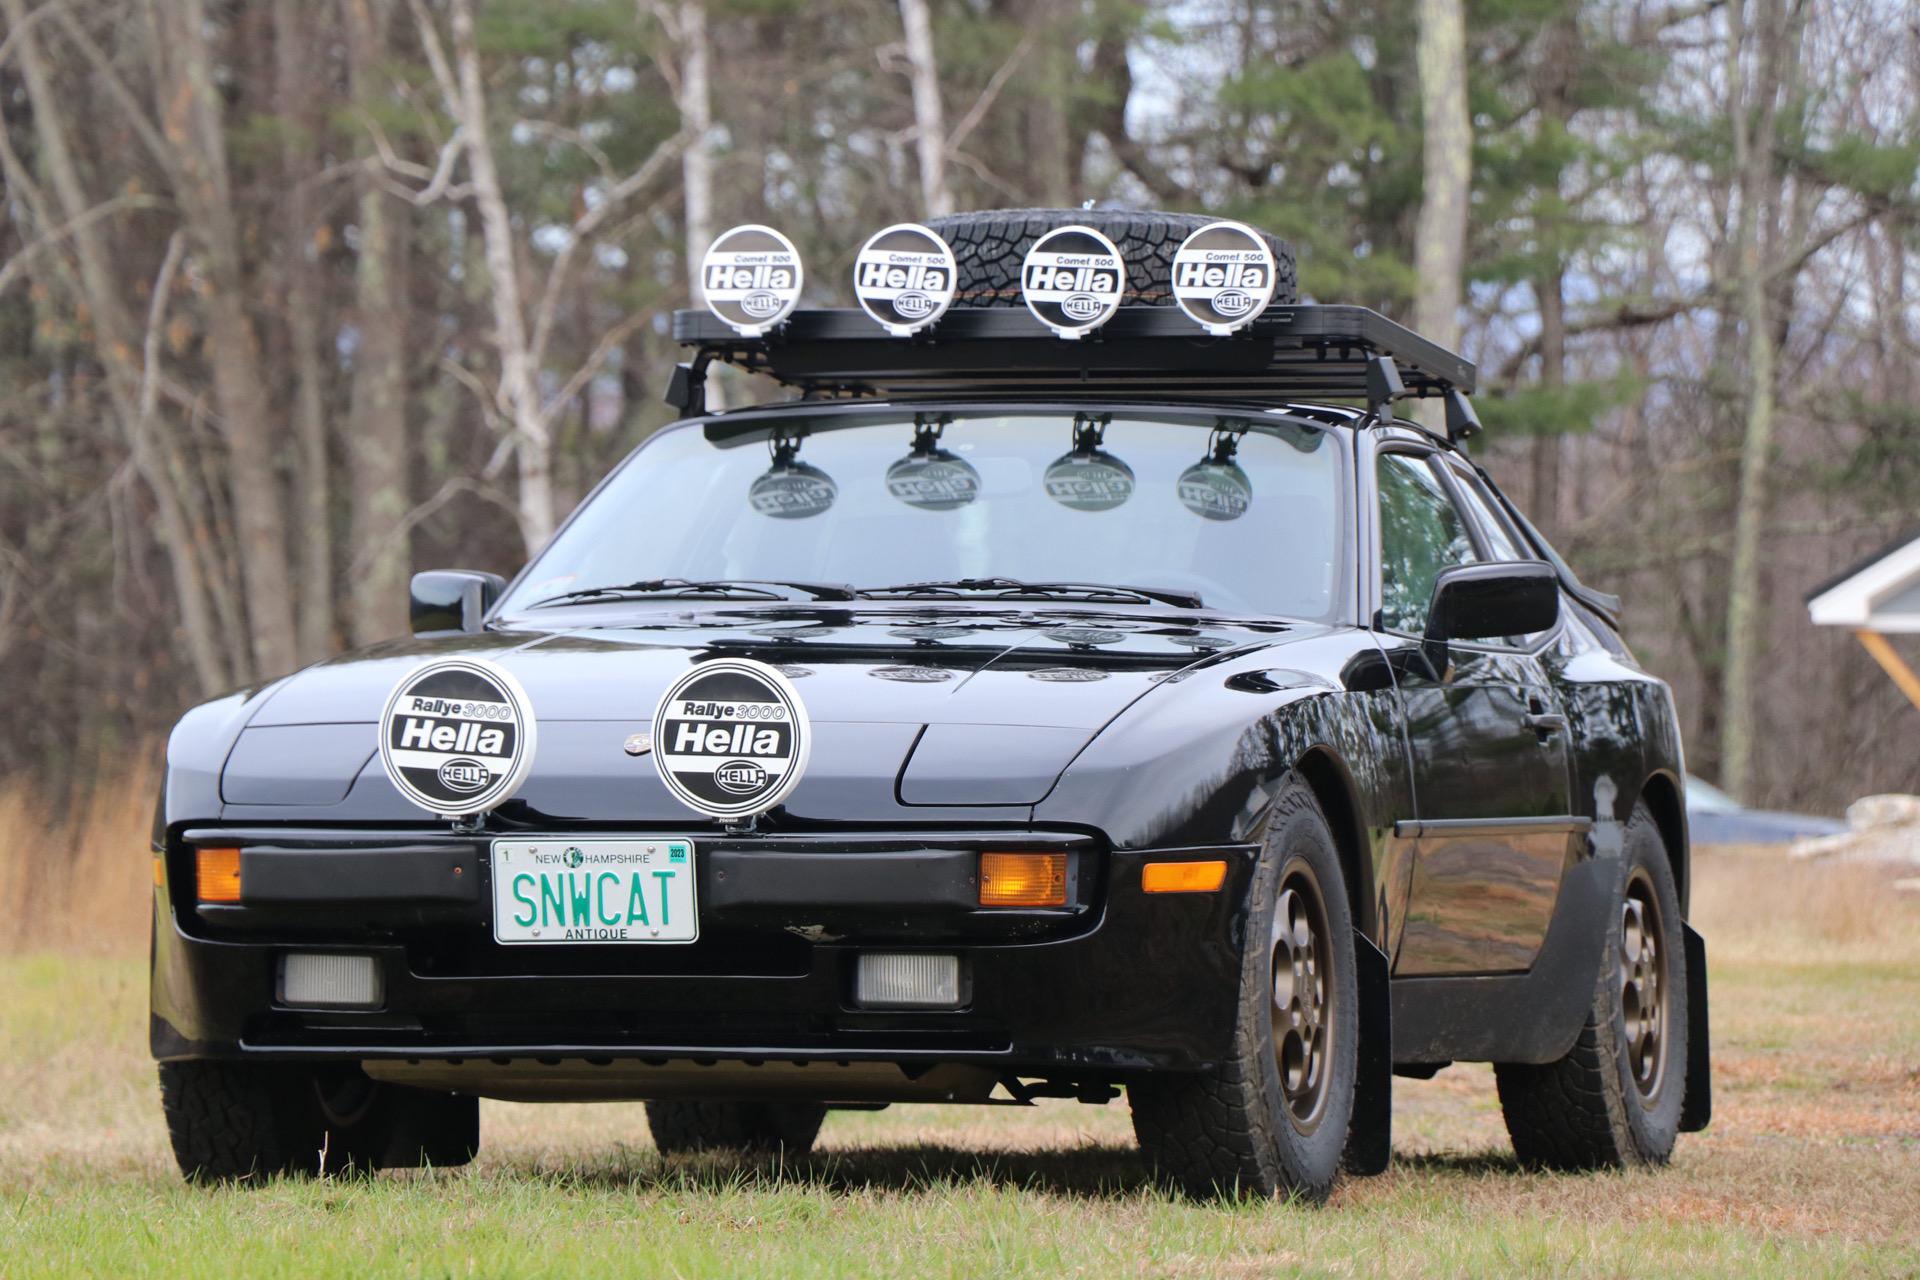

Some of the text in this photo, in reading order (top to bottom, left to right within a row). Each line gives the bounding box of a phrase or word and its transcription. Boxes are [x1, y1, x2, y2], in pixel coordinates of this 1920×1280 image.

[734, 254, 791, 263] Comet 500
[889, 253, 945, 265] Comet 500
[1056, 256, 1114, 266] Comet 500
[1206, 252, 1264, 261] Comet 500
[709, 266, 791, 289] Hella
[861, 263, 945, 290] Hella
[1029, 266, 1113, 292] Hella
[1179, 263, 1264, 288] Hella
[1066, 301, 1101, 312] HELLA
[1216, 297, 1251, 308] HELLA
[412, 698, 511, 720] Rallye 3000
[683, 702, 786, 720] Rallye 3000
[400, 718, 504, 754] Hella
[674, 723, 780, 754] Hella
[443, 767, 489, 783] HELLA
[719, 769, 766, 784] HELLA
[503, 850, 510, 861] 1
[535, 854, 561, 864] NEW
[585, 854, 650, 864] HAMPSHIRE
[670, 848, 685, 858] 2023
[513, 871, 676, 927] SNWCAT
[565, 929, 628, 939] ANTIQUE
